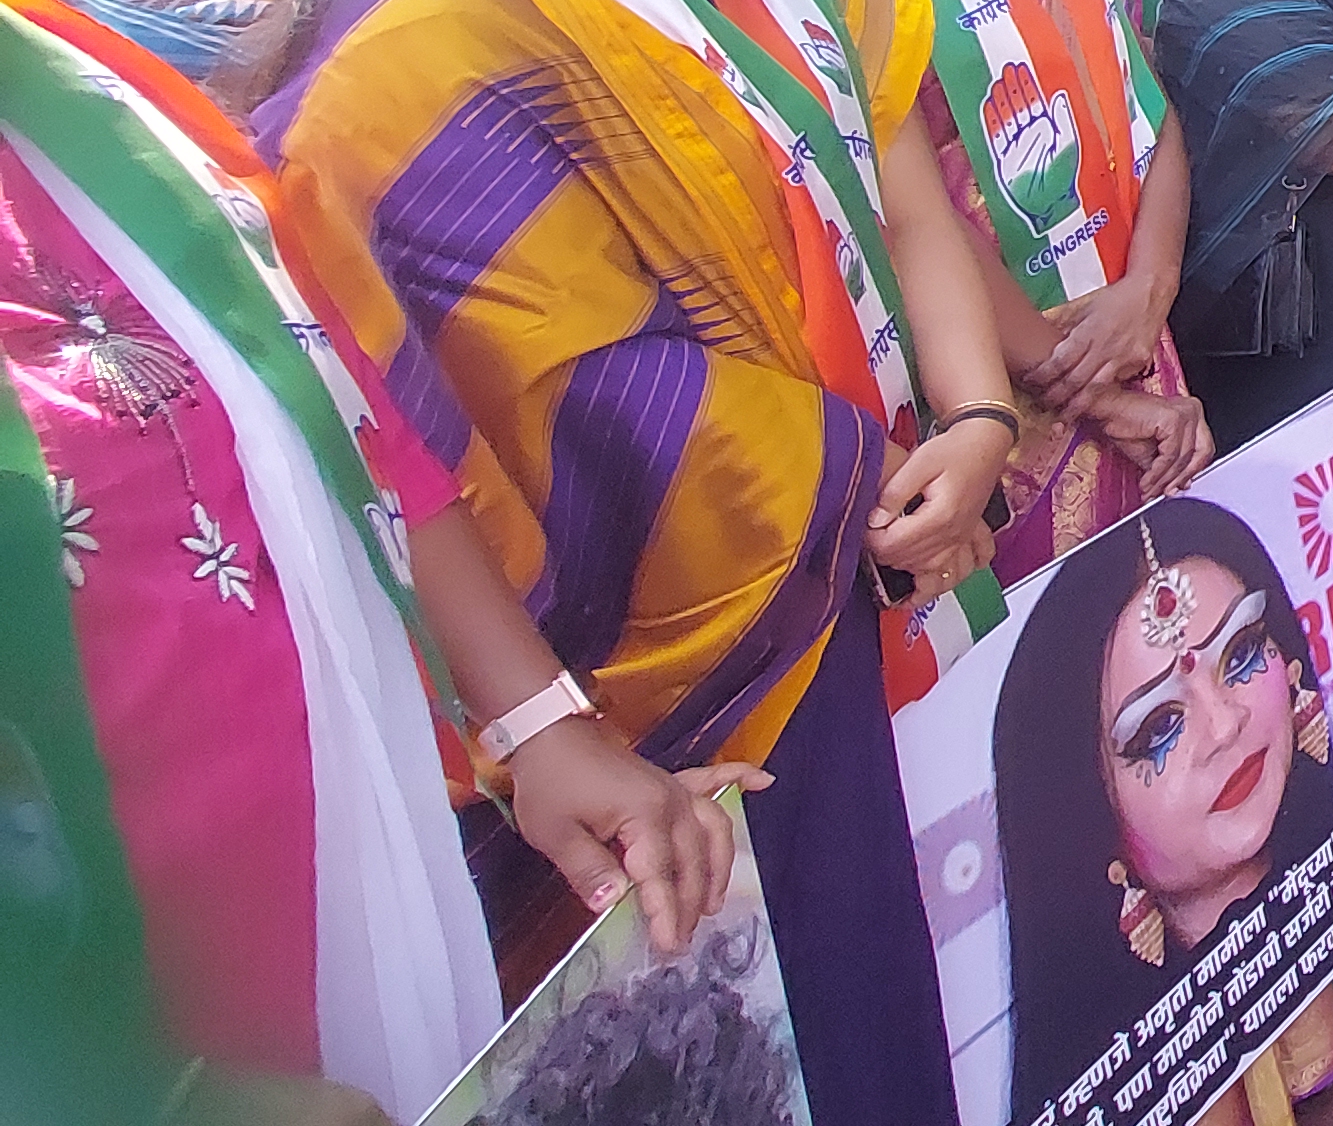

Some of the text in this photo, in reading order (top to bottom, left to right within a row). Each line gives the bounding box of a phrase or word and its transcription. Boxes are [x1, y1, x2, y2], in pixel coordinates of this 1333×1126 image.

[1028, 209, 1109, 274] CONGRESS
[1058, 1032, 1132, 1117] म्हणजे
[1134, 973, 1194, 1048] अमृता
[1193, 902, 1267, 986] मामीला
[1113, 1061, 1153, 1113] पण
[1152, 990, 1224, 1076] मामीने
[1223, 930, 1283, 1007] तोंडाची
[1281, 881, 1333, 949] सर्जरी
[1239, 963, 1300, 1034] यातला
